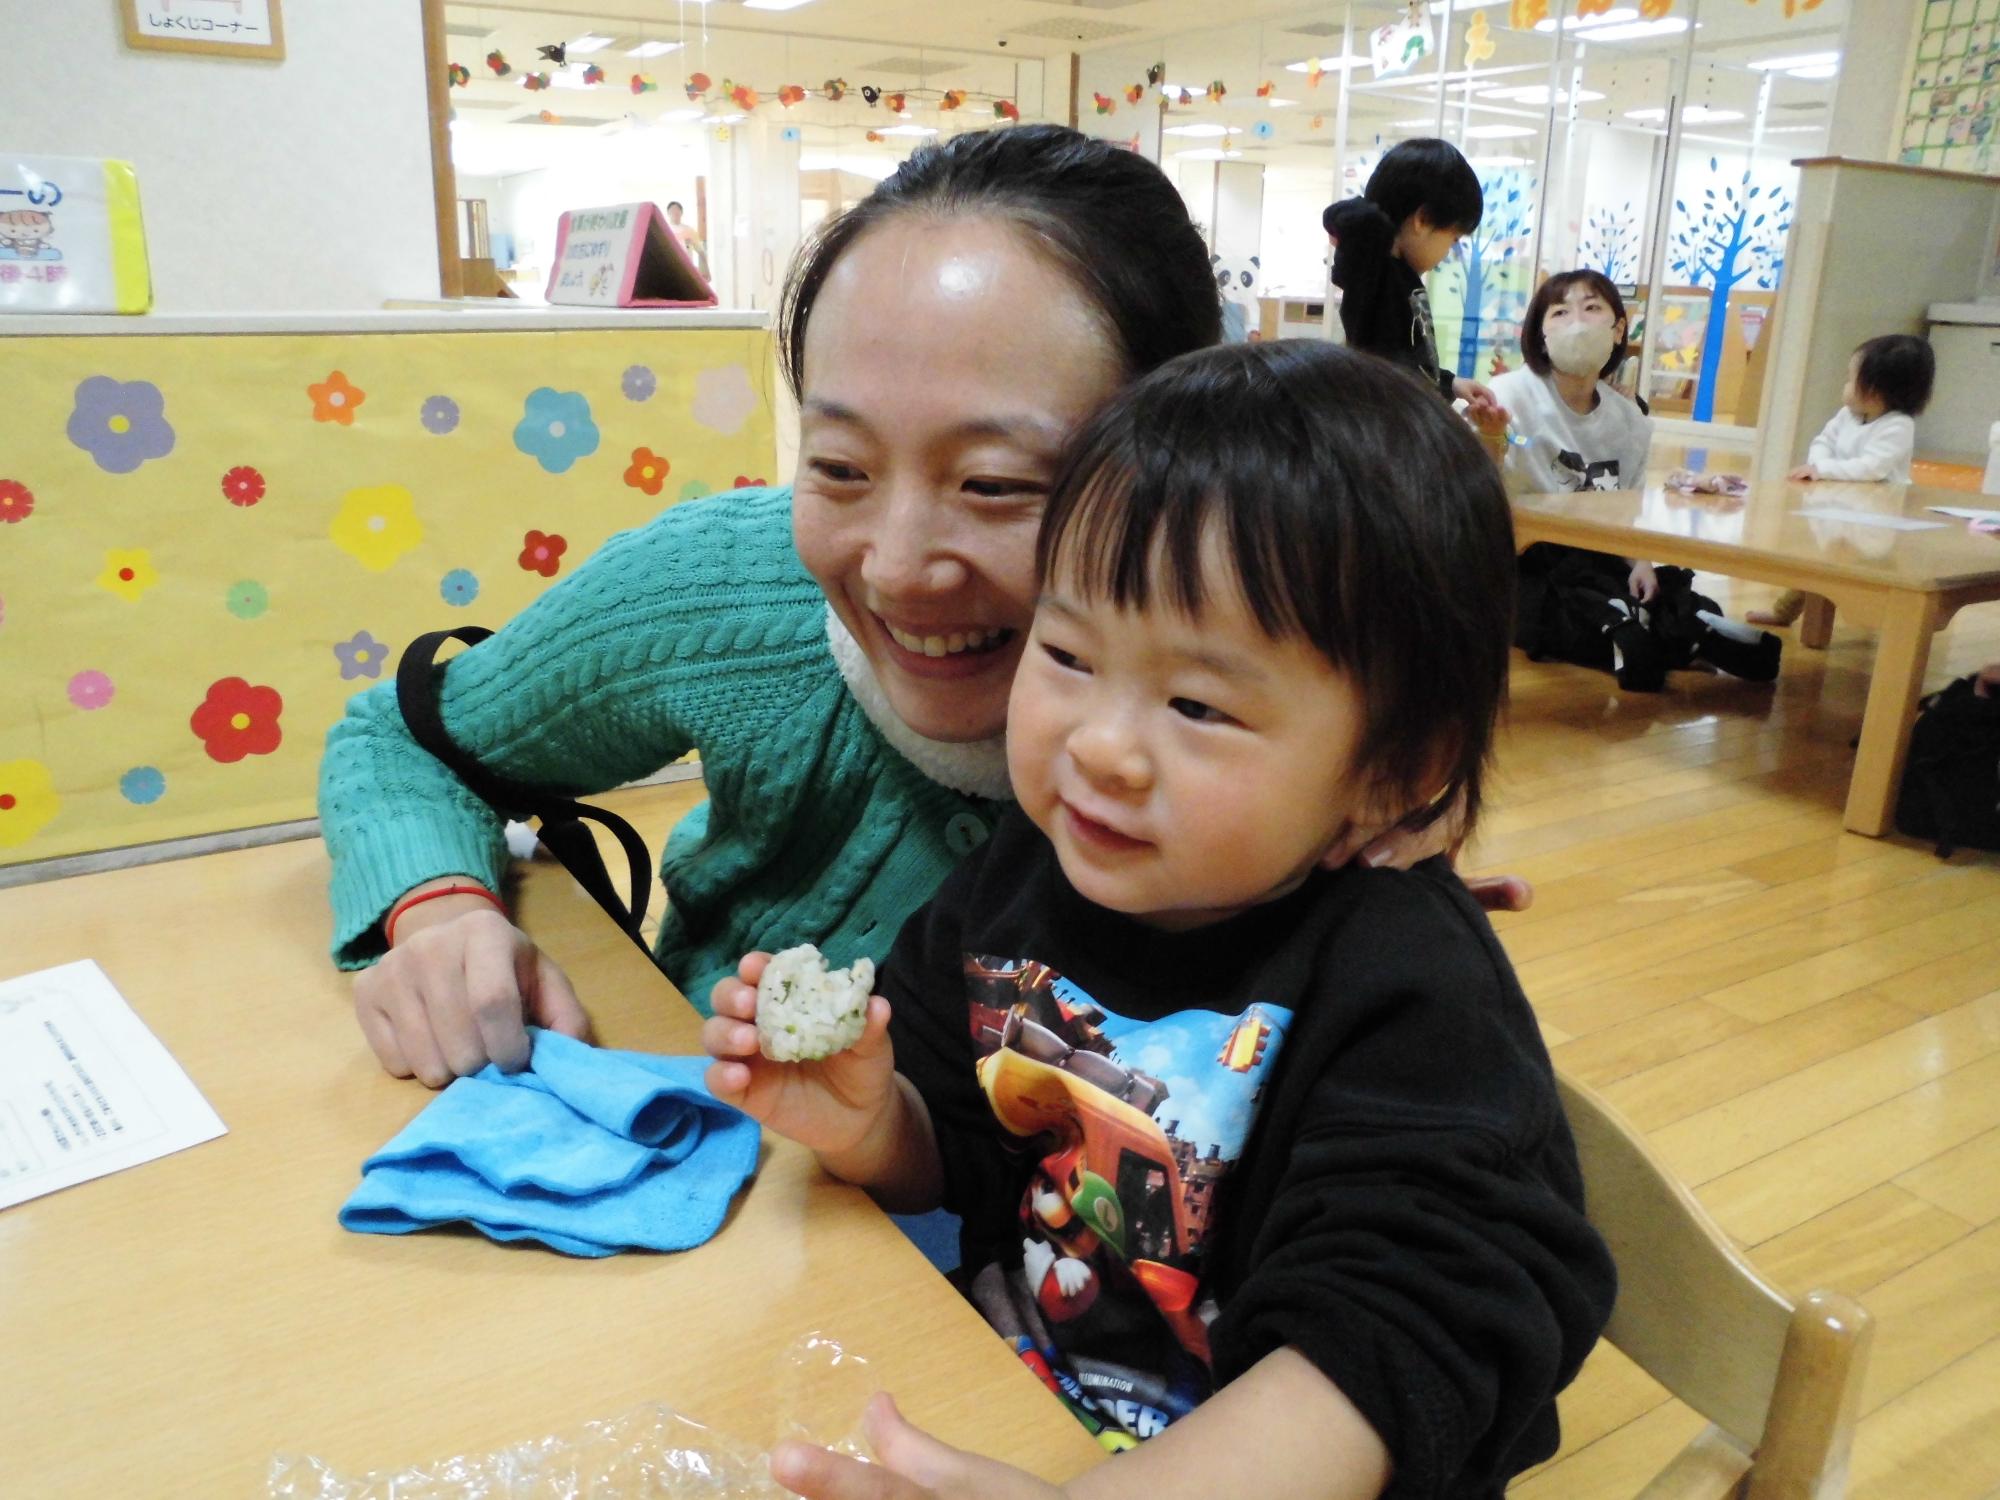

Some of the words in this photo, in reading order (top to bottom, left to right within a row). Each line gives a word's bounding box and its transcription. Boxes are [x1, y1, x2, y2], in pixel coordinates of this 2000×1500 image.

[148, 12, 259, 33] しょくじコーナー
